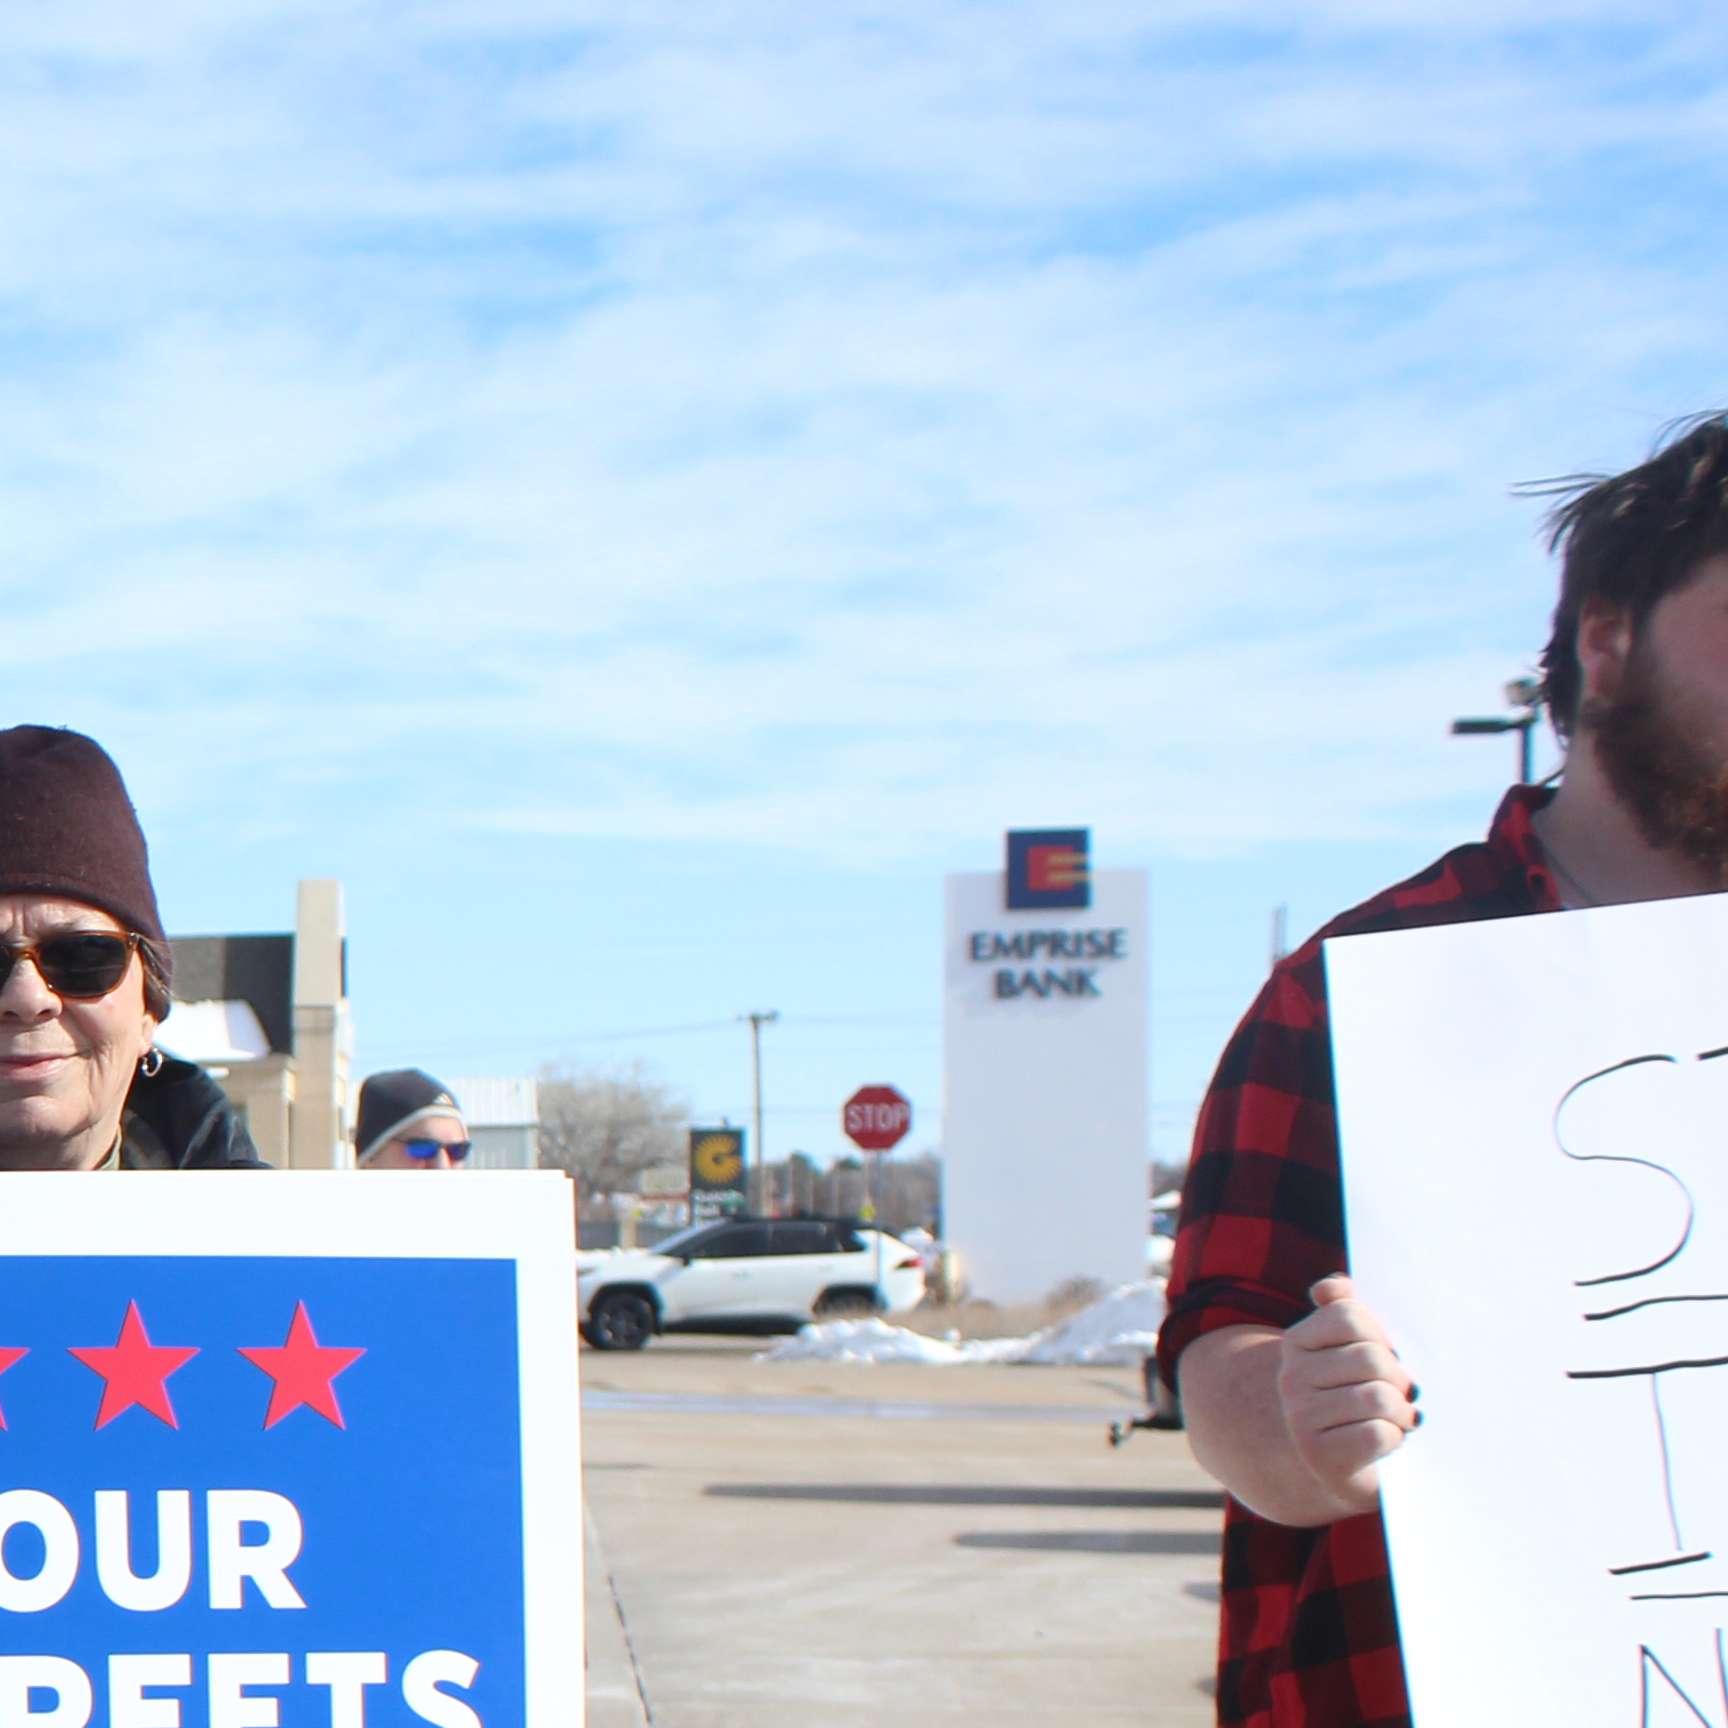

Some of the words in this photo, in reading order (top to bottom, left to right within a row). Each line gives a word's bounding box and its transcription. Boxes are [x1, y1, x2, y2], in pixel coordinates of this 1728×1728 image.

[970, 929, 1129, 962] EMPRISE
[994, 966, 1102, 999] BANK
[847, 1102, 910, 1133] STOP
